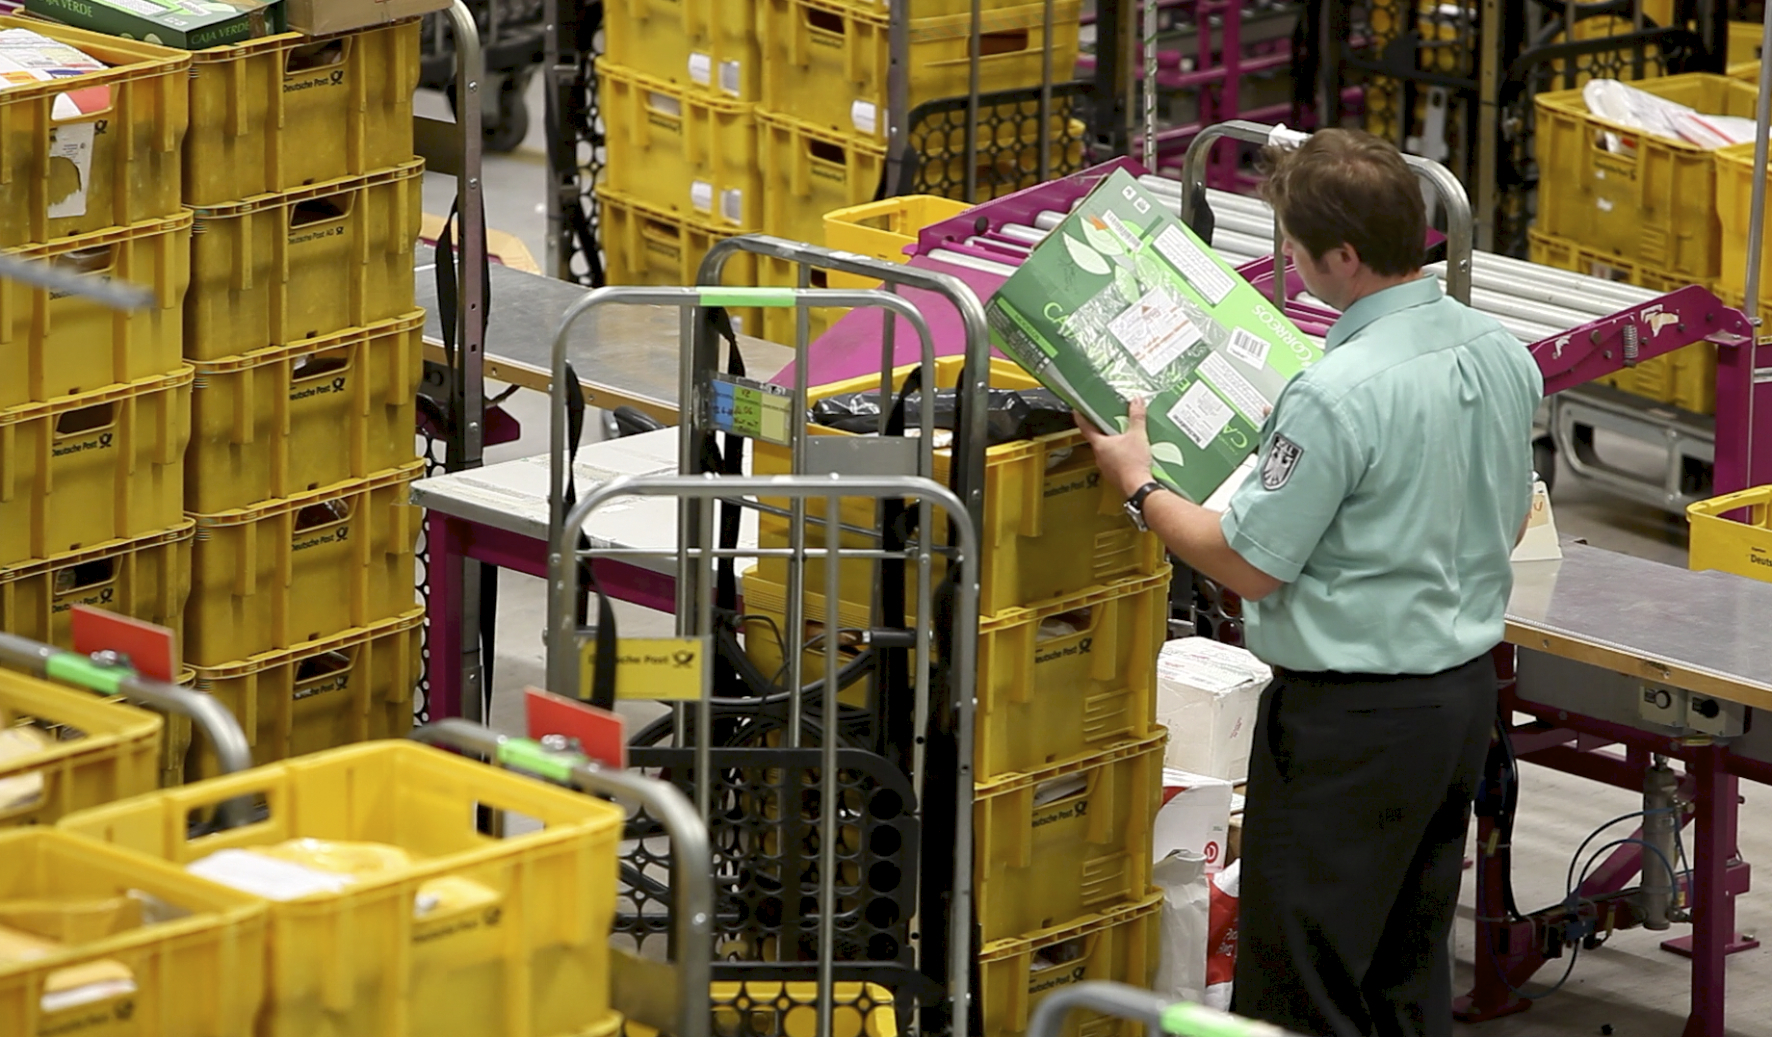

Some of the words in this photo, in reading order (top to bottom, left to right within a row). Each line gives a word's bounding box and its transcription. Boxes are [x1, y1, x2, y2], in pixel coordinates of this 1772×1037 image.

[191, 31, 217, 45] CAJA
[219, 21, 250, 37] VERDE
[283, 81, 313, 93] Deutsche
[314, 78, 329, 87] Post
[1251, 304, 1312, 361] CORREOS
[290, 388, 316, 400] eutsche
[316, 385, 331, 394] Post
[1223, 424, 1248, 448] CA
[82, 441, 97, 450] Post
[1043, 485, 1070, 498] eutsche
[1070, 481, 1085, 490] Post
[320, 535, 334, 543] Post
[83, 596, 98, 605] Post
[643, 653, 668, 665] Post
[1035, 651, 1062, 663] eutsche
[1063, 646, 1077, 655] Post
[1032, 815, 1058, 828] eutsche
[1059, 809, 1073, 819] Post
[1028, 981, 1055, 994] eutsche
[1056, 974, 1070, 984] Post
